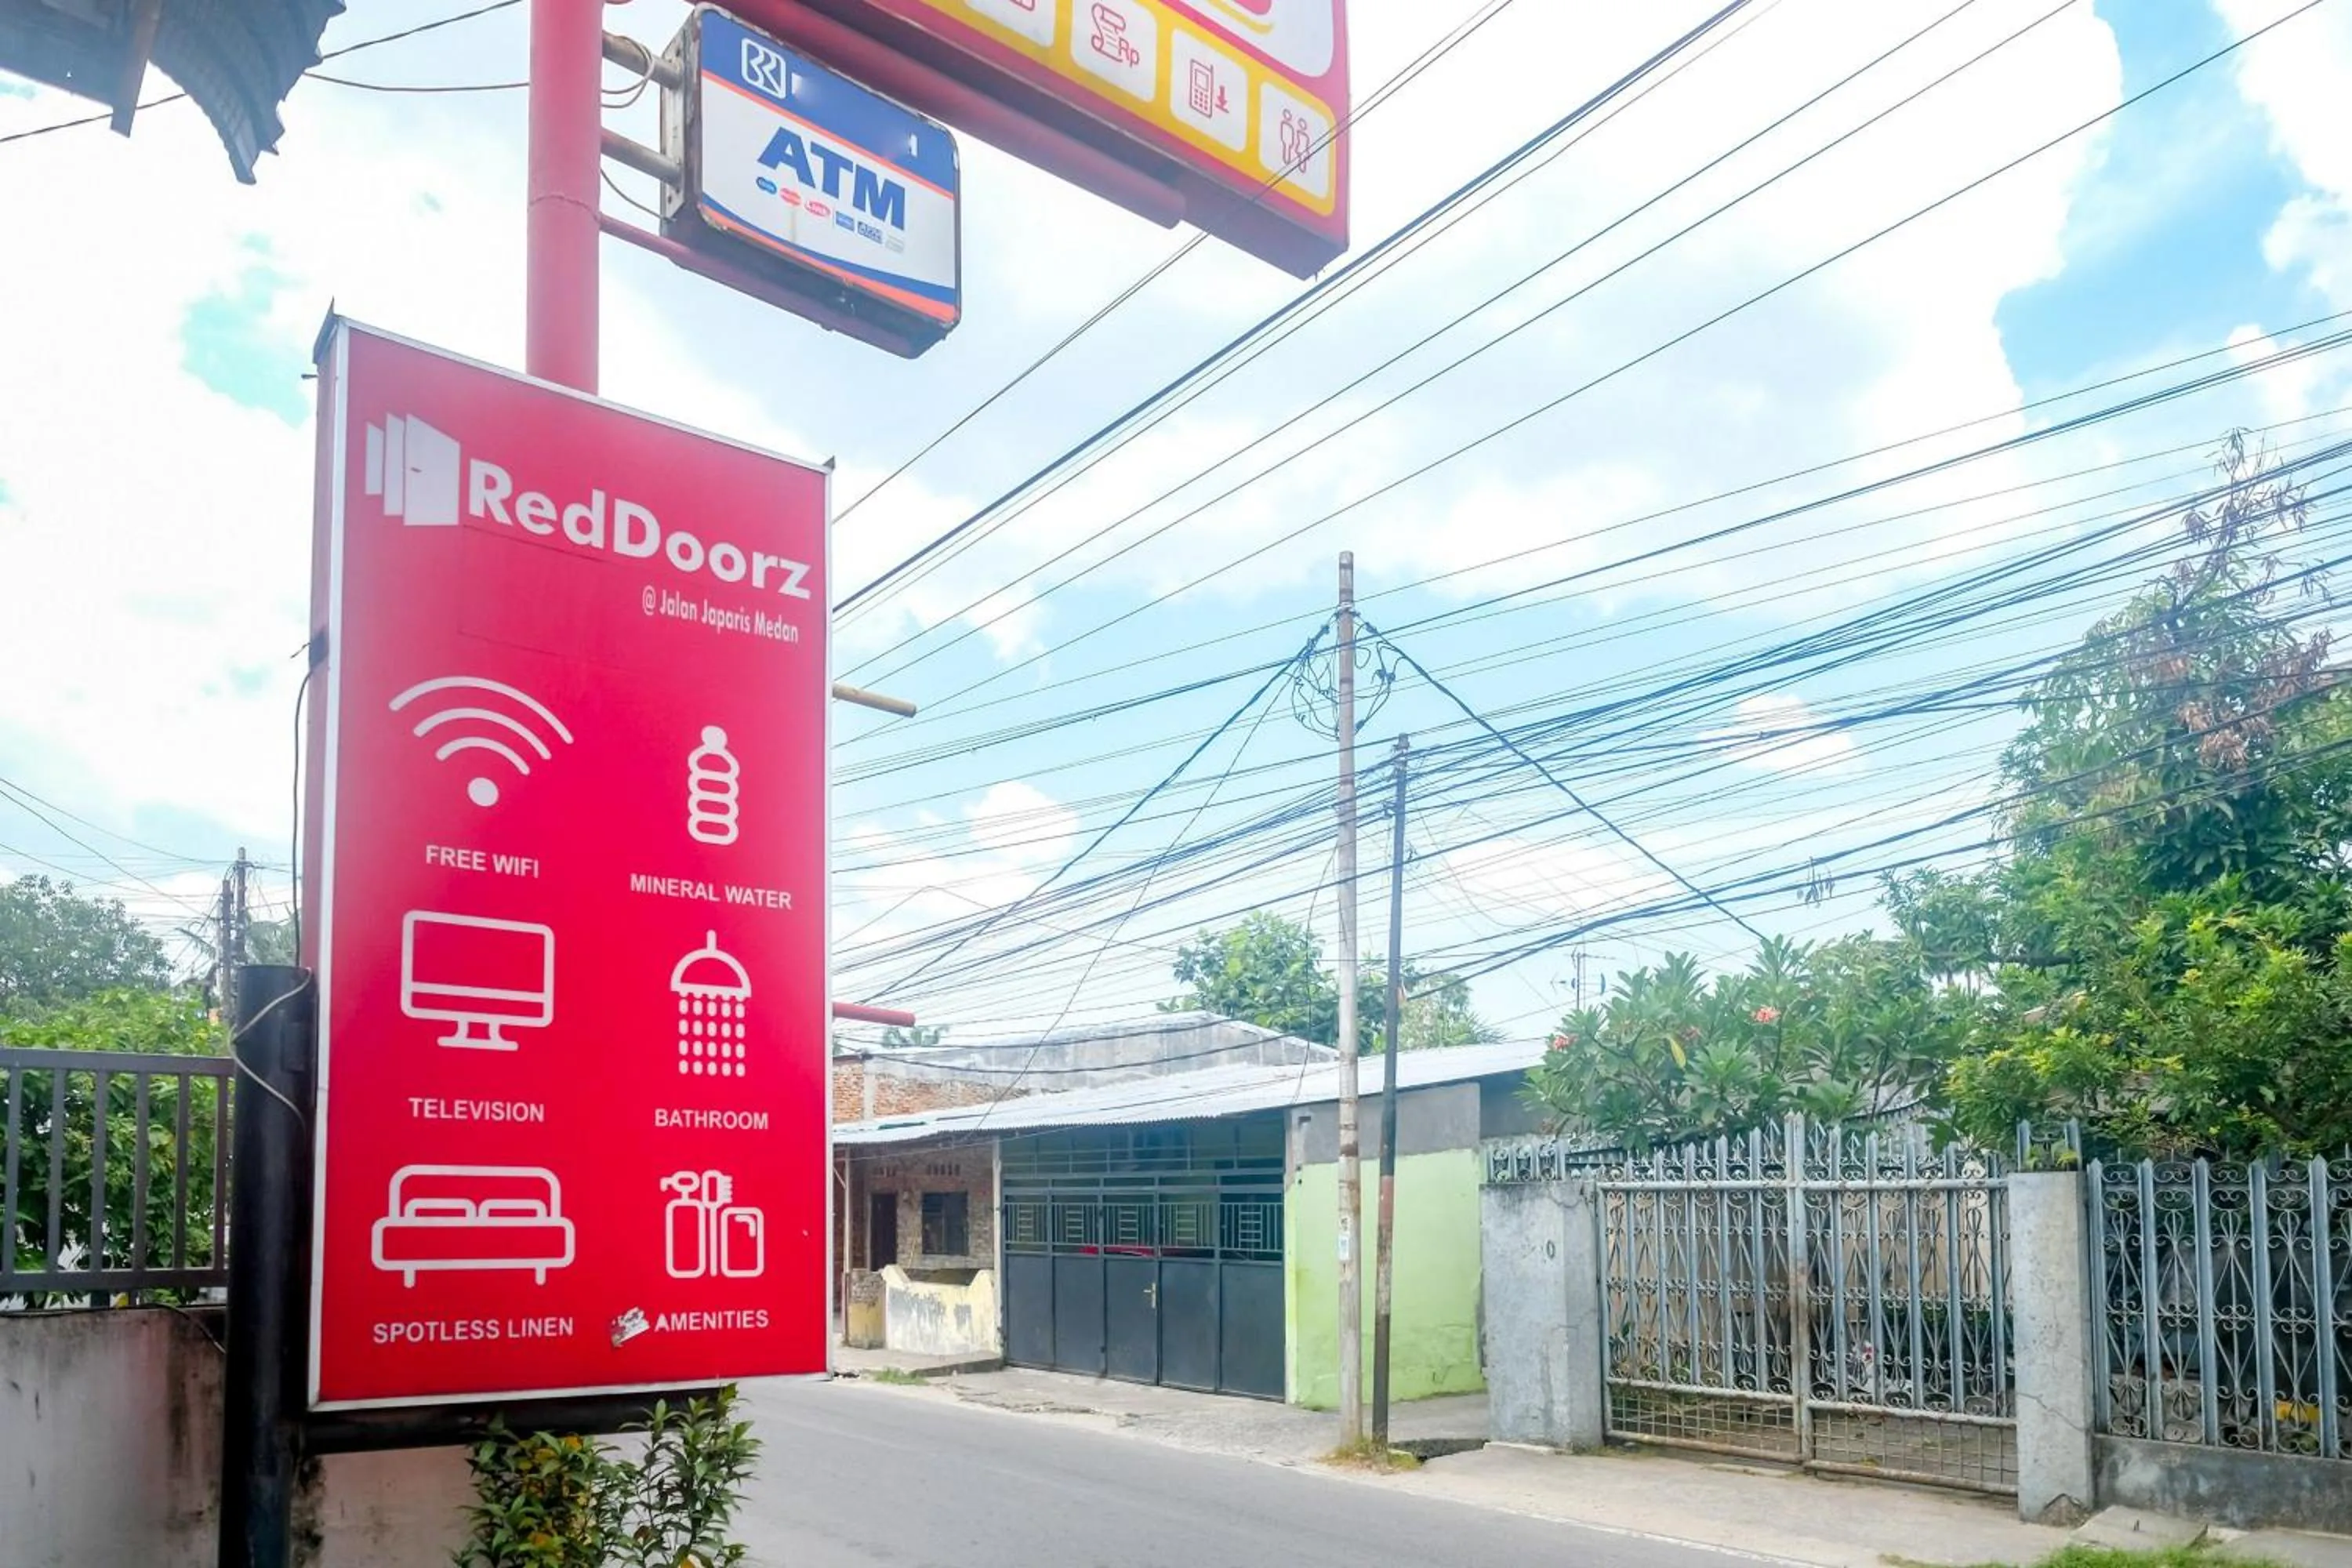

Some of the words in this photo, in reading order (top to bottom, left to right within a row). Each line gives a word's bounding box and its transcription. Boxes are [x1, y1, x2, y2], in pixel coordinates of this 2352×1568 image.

[757, 125, 906, 230] ATM
[469, 458, 811, 600] RedDoorz
[659, 589, 697, 622] Jalan
[701, 598, 750, 634] Japaris
[753, 611, 798, 644] Medan
[426, 844, 486, 871] FREE
[492, 855, 539, 878] WIFI
[630, 873, 720, 902] MINERAL
[725, 885, 792, 909] WATER
[408, 1098, 545, 1122] TELEVISION
[655, 1109, 768, 1130] BATHROOM
[373, 1319, 499, 1343] SPOTLESS
[508, 1317, 574, 1338] LINEN
[655, 1309, 769, 1332] AMENITIES
